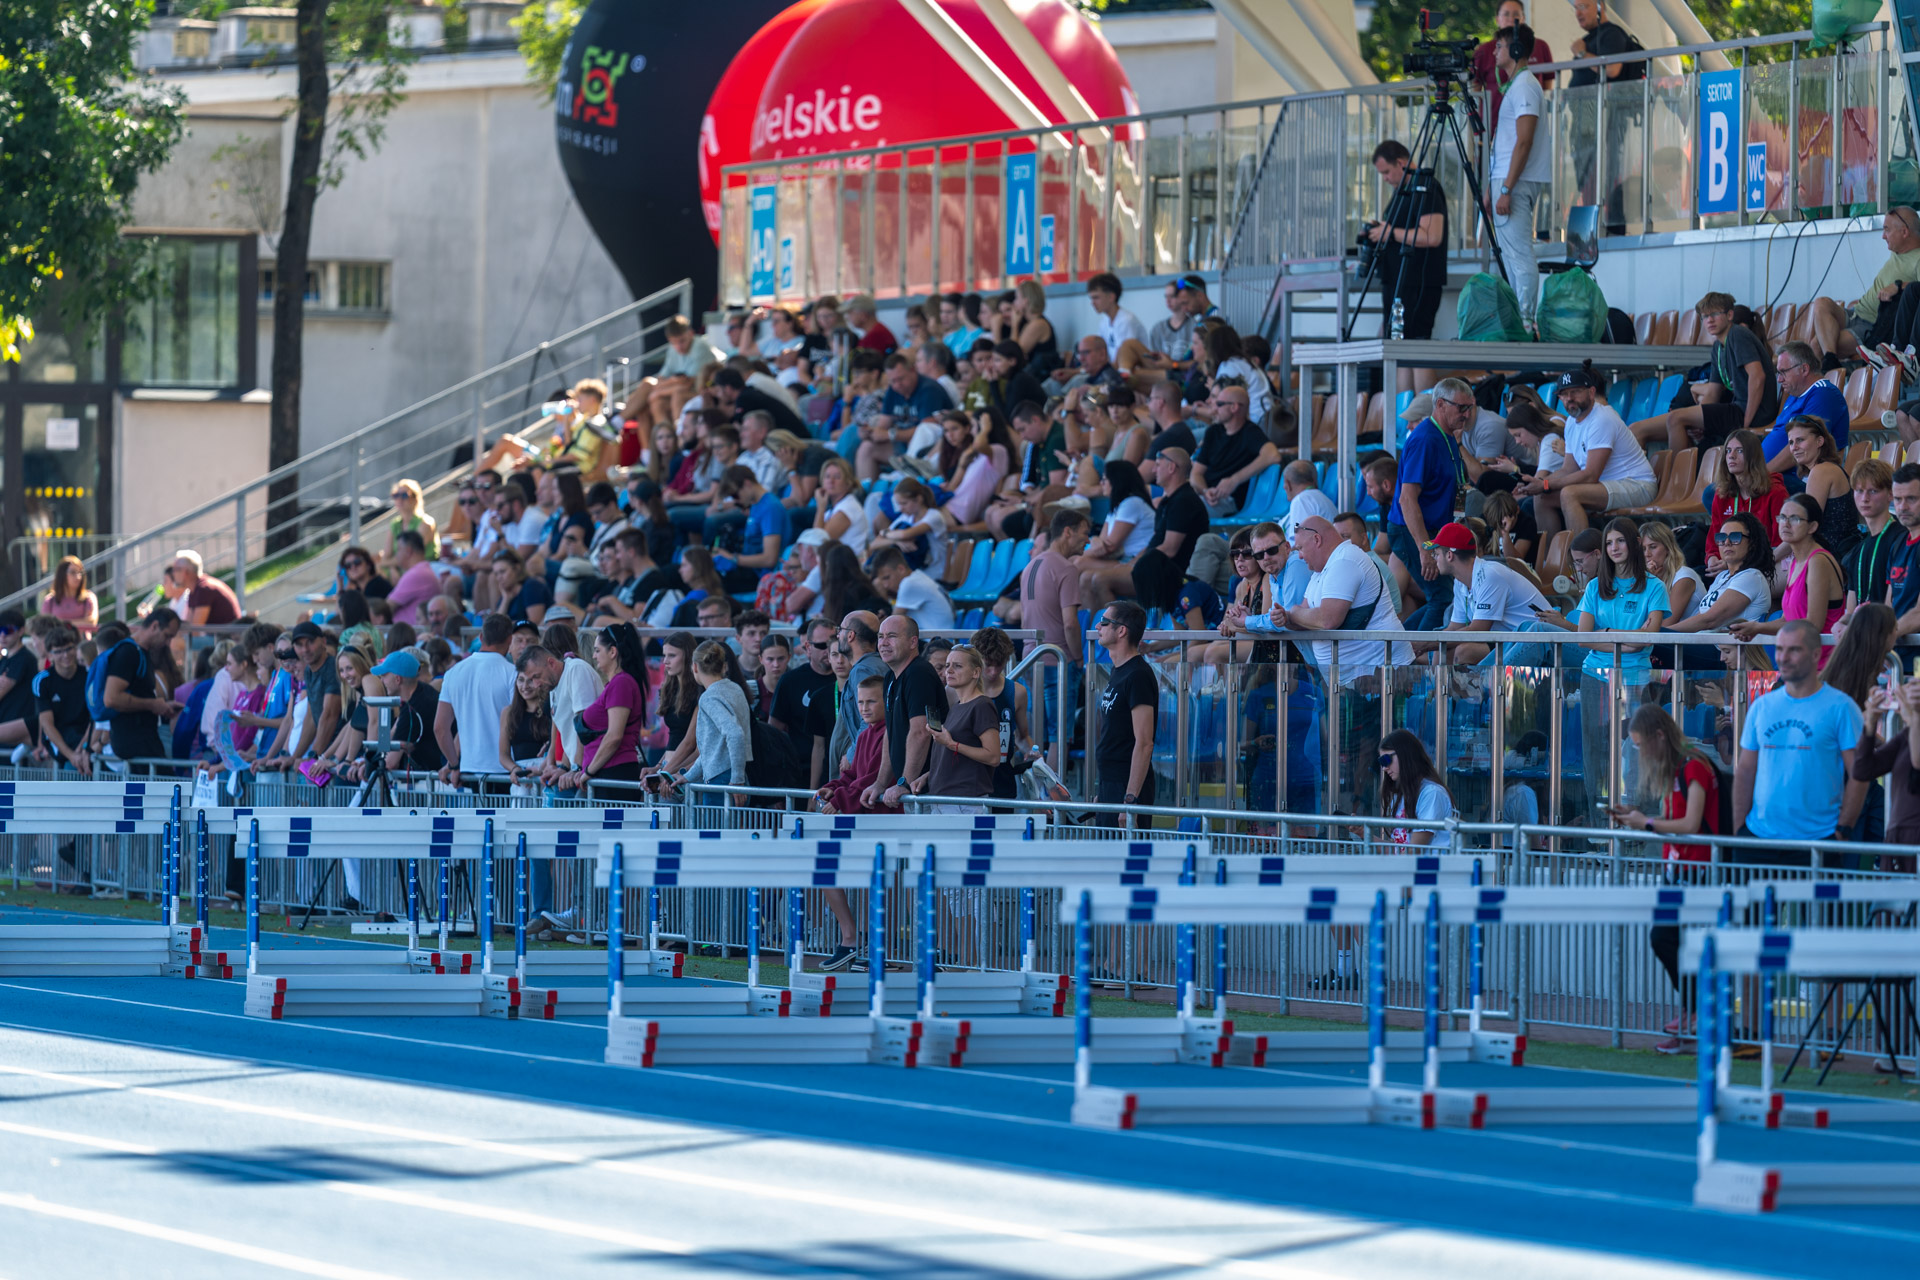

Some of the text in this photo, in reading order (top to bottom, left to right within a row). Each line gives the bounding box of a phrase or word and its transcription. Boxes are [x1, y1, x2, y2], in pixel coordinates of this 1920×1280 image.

[1707, 82, 1733, 102] SEKTOR
[1708, 111, 1729, 202] B
[1748, 153, 1765, 182] WC
[1012, 189, 1030, 264] A
[1764, 719, 1813, 740] HILFIGER
